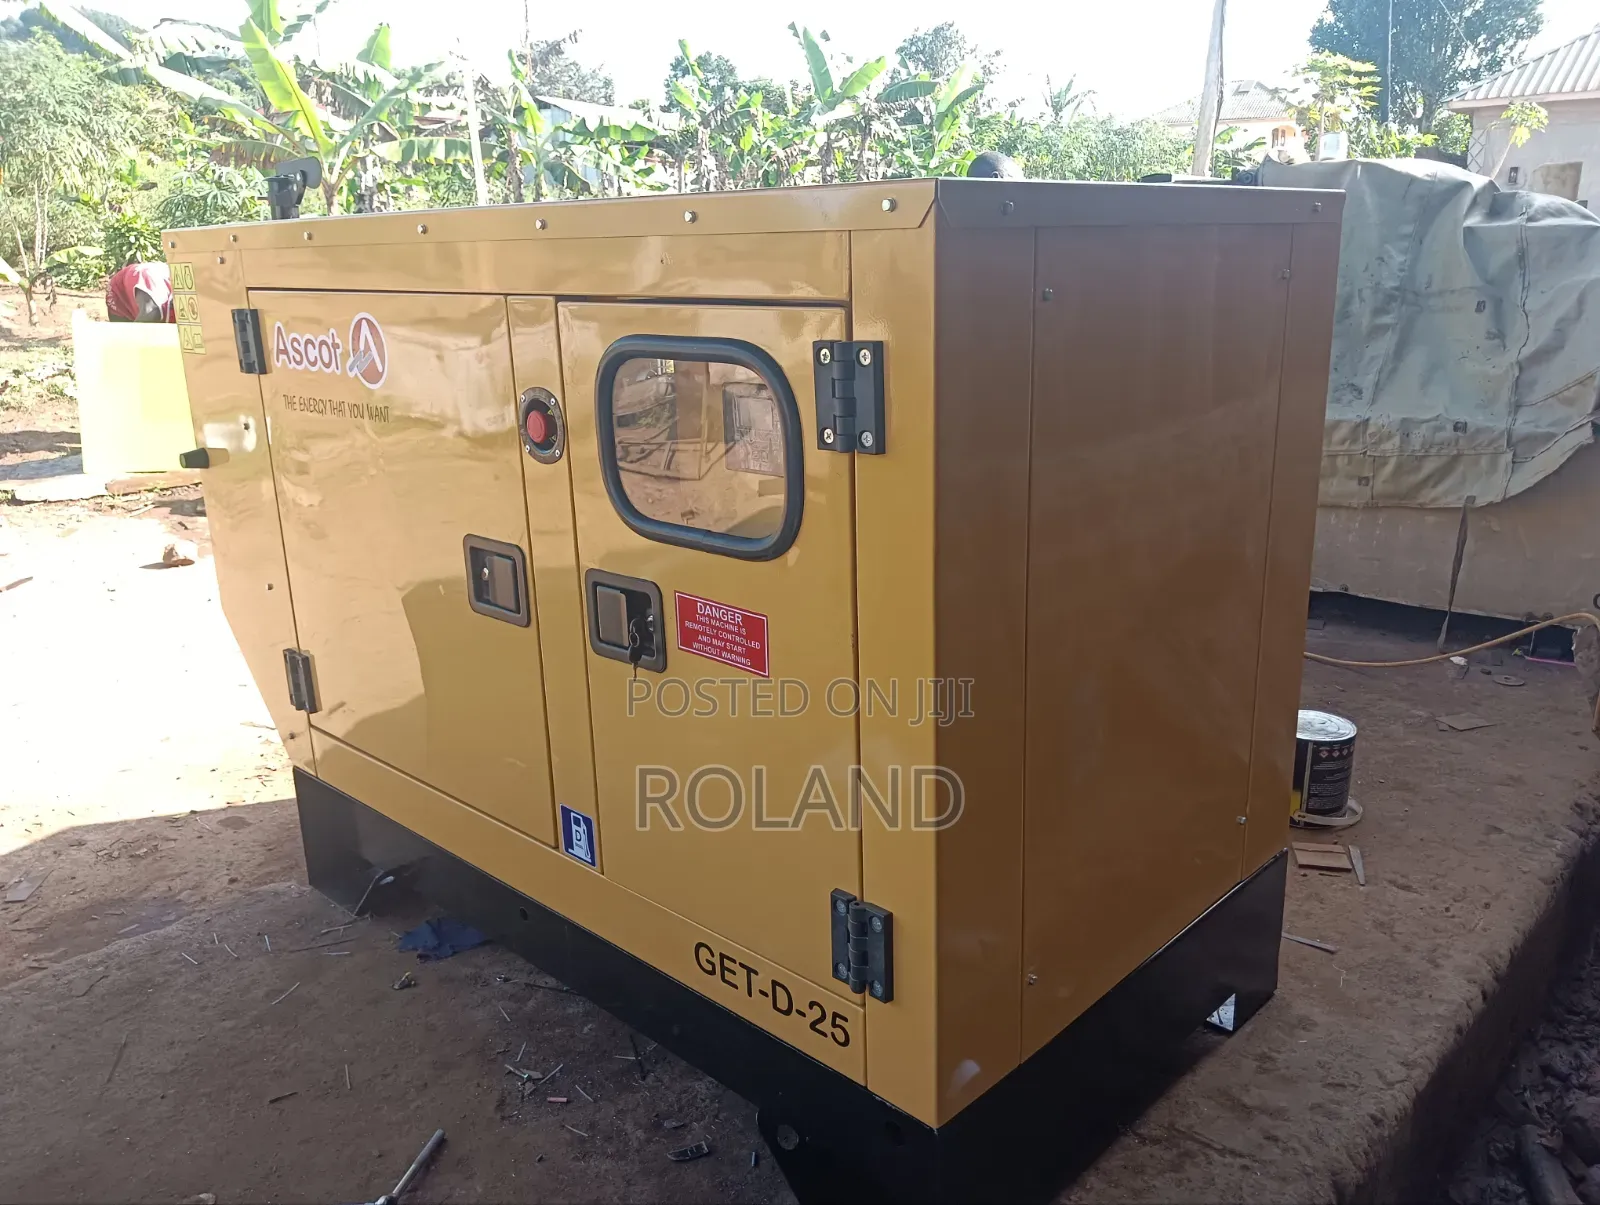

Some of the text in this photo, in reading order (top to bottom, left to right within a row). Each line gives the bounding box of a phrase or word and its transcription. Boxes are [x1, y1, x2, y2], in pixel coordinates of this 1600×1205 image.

[275, 325, 342, 372] Ascot
[283, 394, 390, 423] THE ENERGY THAT YOU WANT
[696, 614, 747, 635] THIS MACHINE IS
[697, 602, 743, 626] DANGER
[684, 620, 761, 650] REMOTELY CONTROLLED
[697, 634, 747, 655] AND MAY START
[692, 642, 751, 666] WITHOUT WARNING
[574, 829, 582, 842] D
[694, 941, 850, 1048] GET-D-25
